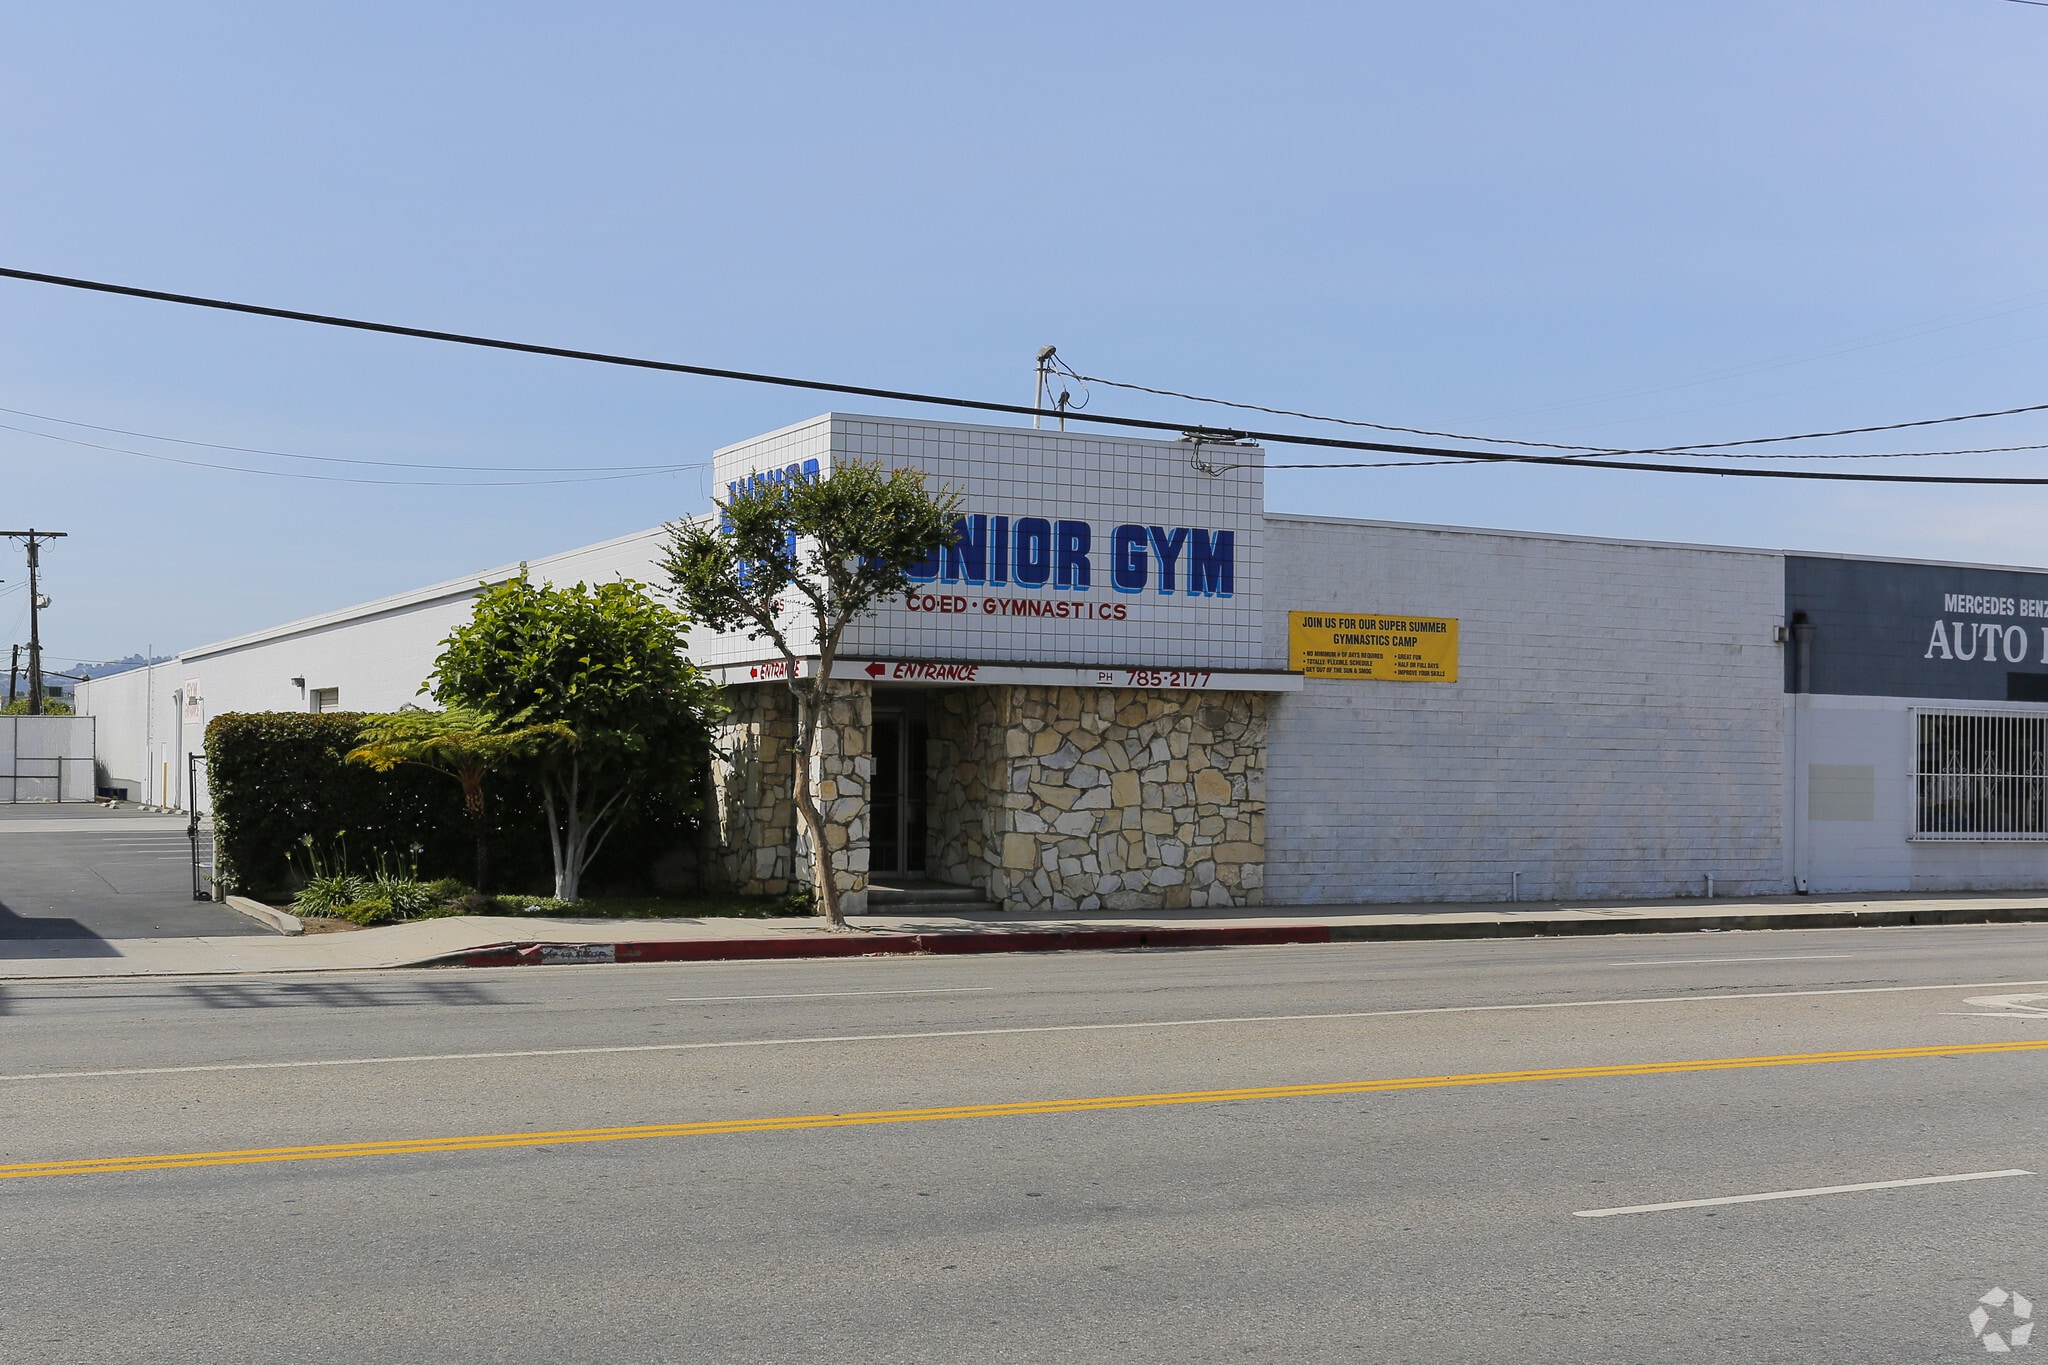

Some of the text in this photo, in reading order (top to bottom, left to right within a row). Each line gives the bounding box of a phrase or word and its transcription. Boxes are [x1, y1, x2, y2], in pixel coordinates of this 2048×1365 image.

[1111, 523, 1235, 598] GYM
[983, 597, 1127, 620] GYMNASTICS
[1944, 593, 2015, 616] MERCEDES
[1302, 616, 1447, 633] JOIN US FOR OUR SUPER SUMMER
[1333, 633, 1418, 647] GYMNASTICS CAMP
[1924, 619, 2028, 663] AUTO
[893, 662, 979, 682] ENTRANCE
[1098, 672, 1113, 681] PH
